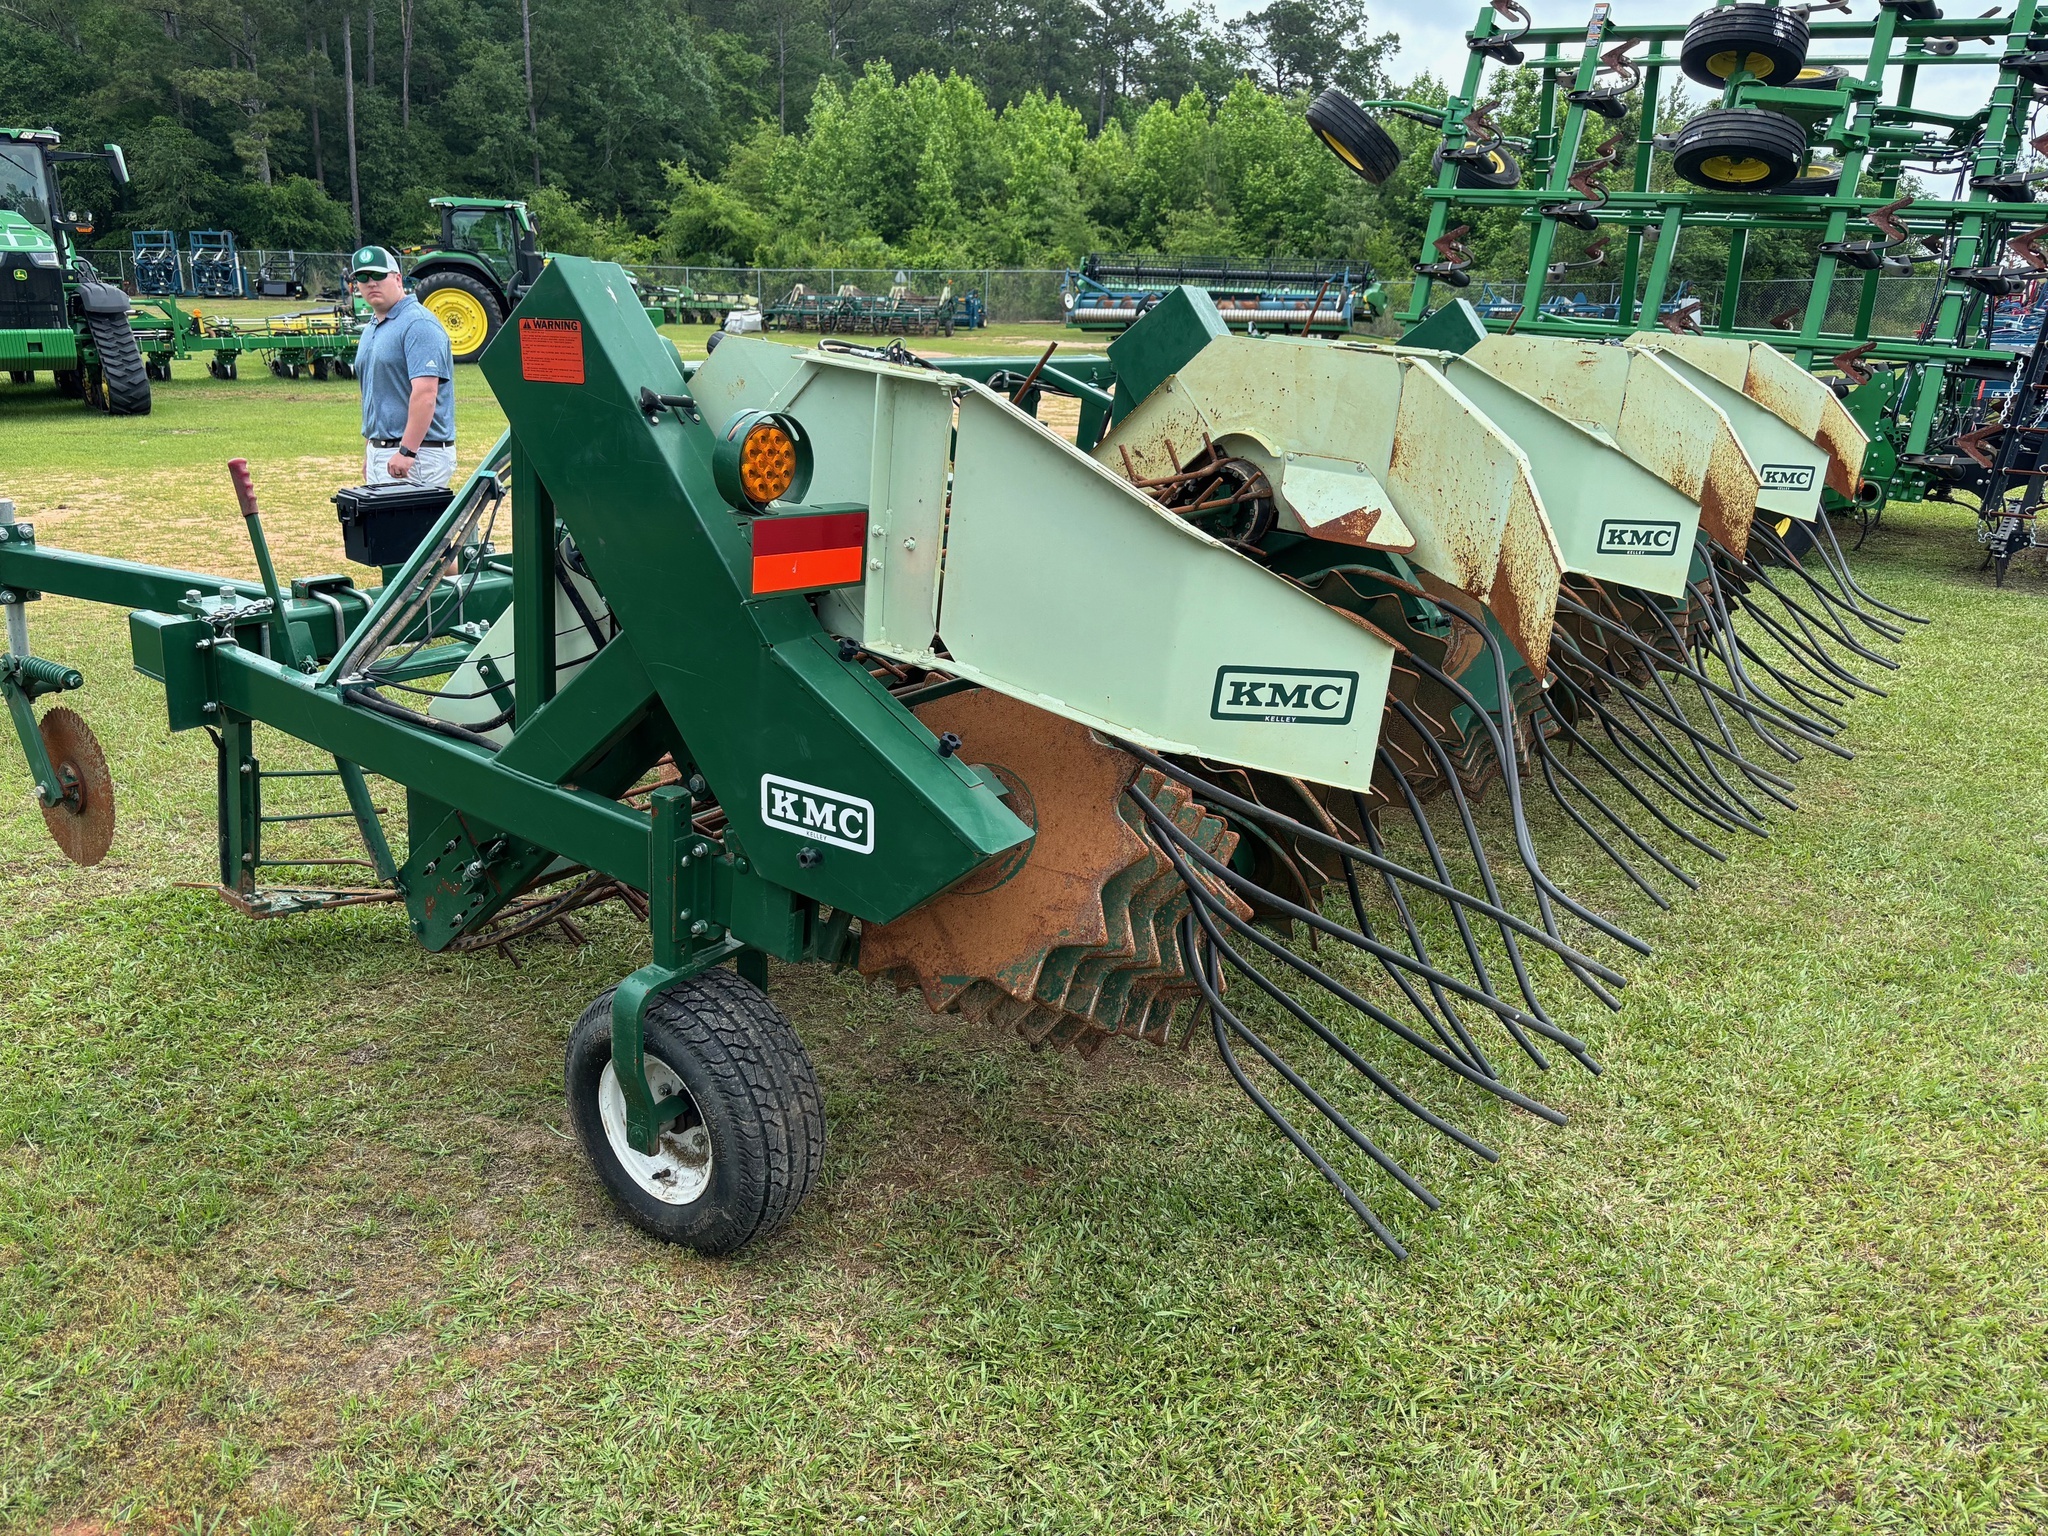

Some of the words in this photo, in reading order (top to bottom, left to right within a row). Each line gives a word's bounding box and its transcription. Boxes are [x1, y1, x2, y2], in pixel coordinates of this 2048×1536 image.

[533, 320, 578, 331] WARNING
[1763, 471, 1809, 485] KMC
[1606, 529, 1672, 547] KMC
[1226, 681, 1343, 710] KMC
[1264, 715, 1297, 723] KELLEY
[771, 787, 863, 839] KMC
[806, 831, 828, 841] KELLEY
